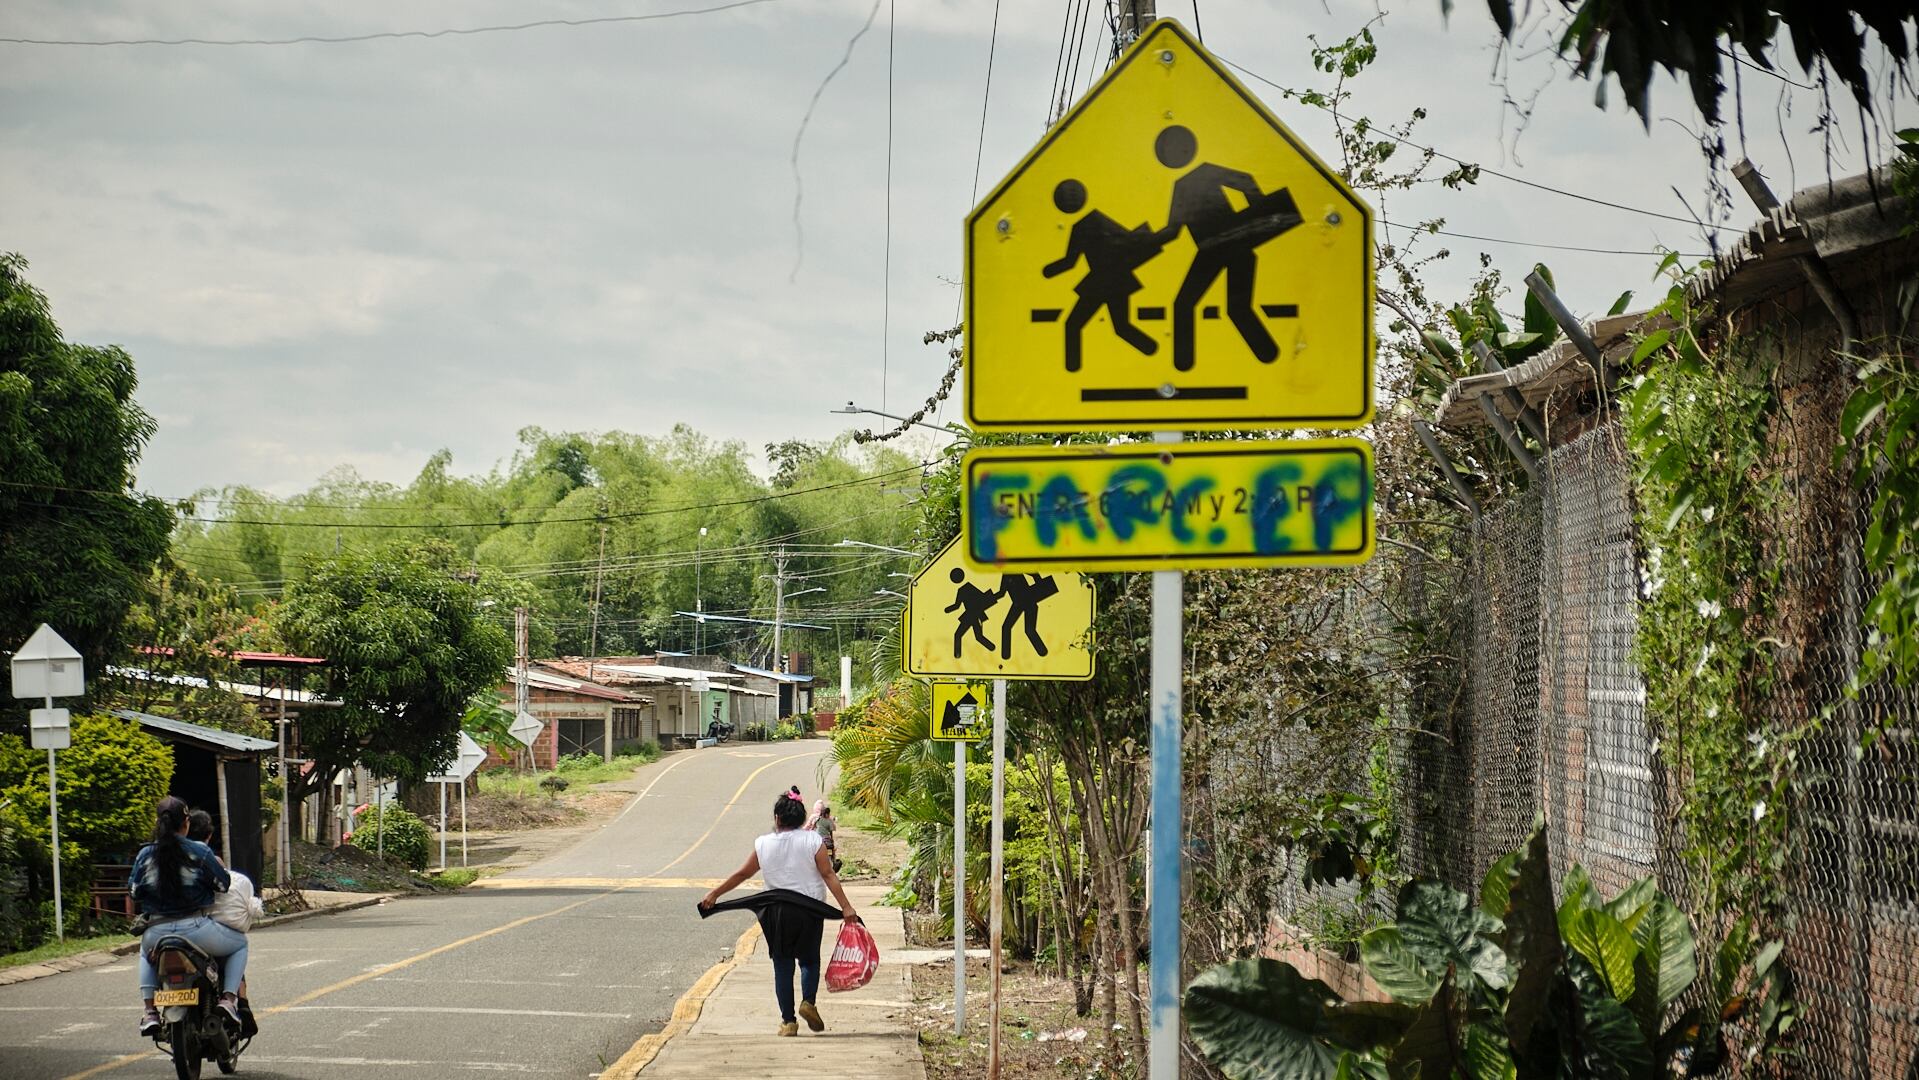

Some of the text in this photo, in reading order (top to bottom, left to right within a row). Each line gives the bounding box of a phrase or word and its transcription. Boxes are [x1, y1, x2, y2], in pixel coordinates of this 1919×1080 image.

[1000, 491, 1089, 519] ENRE
[1160, 487, 1202, 517] AM
[1210, 494, 1226, 522] y
[1252, 457, 1373, 554] EP
